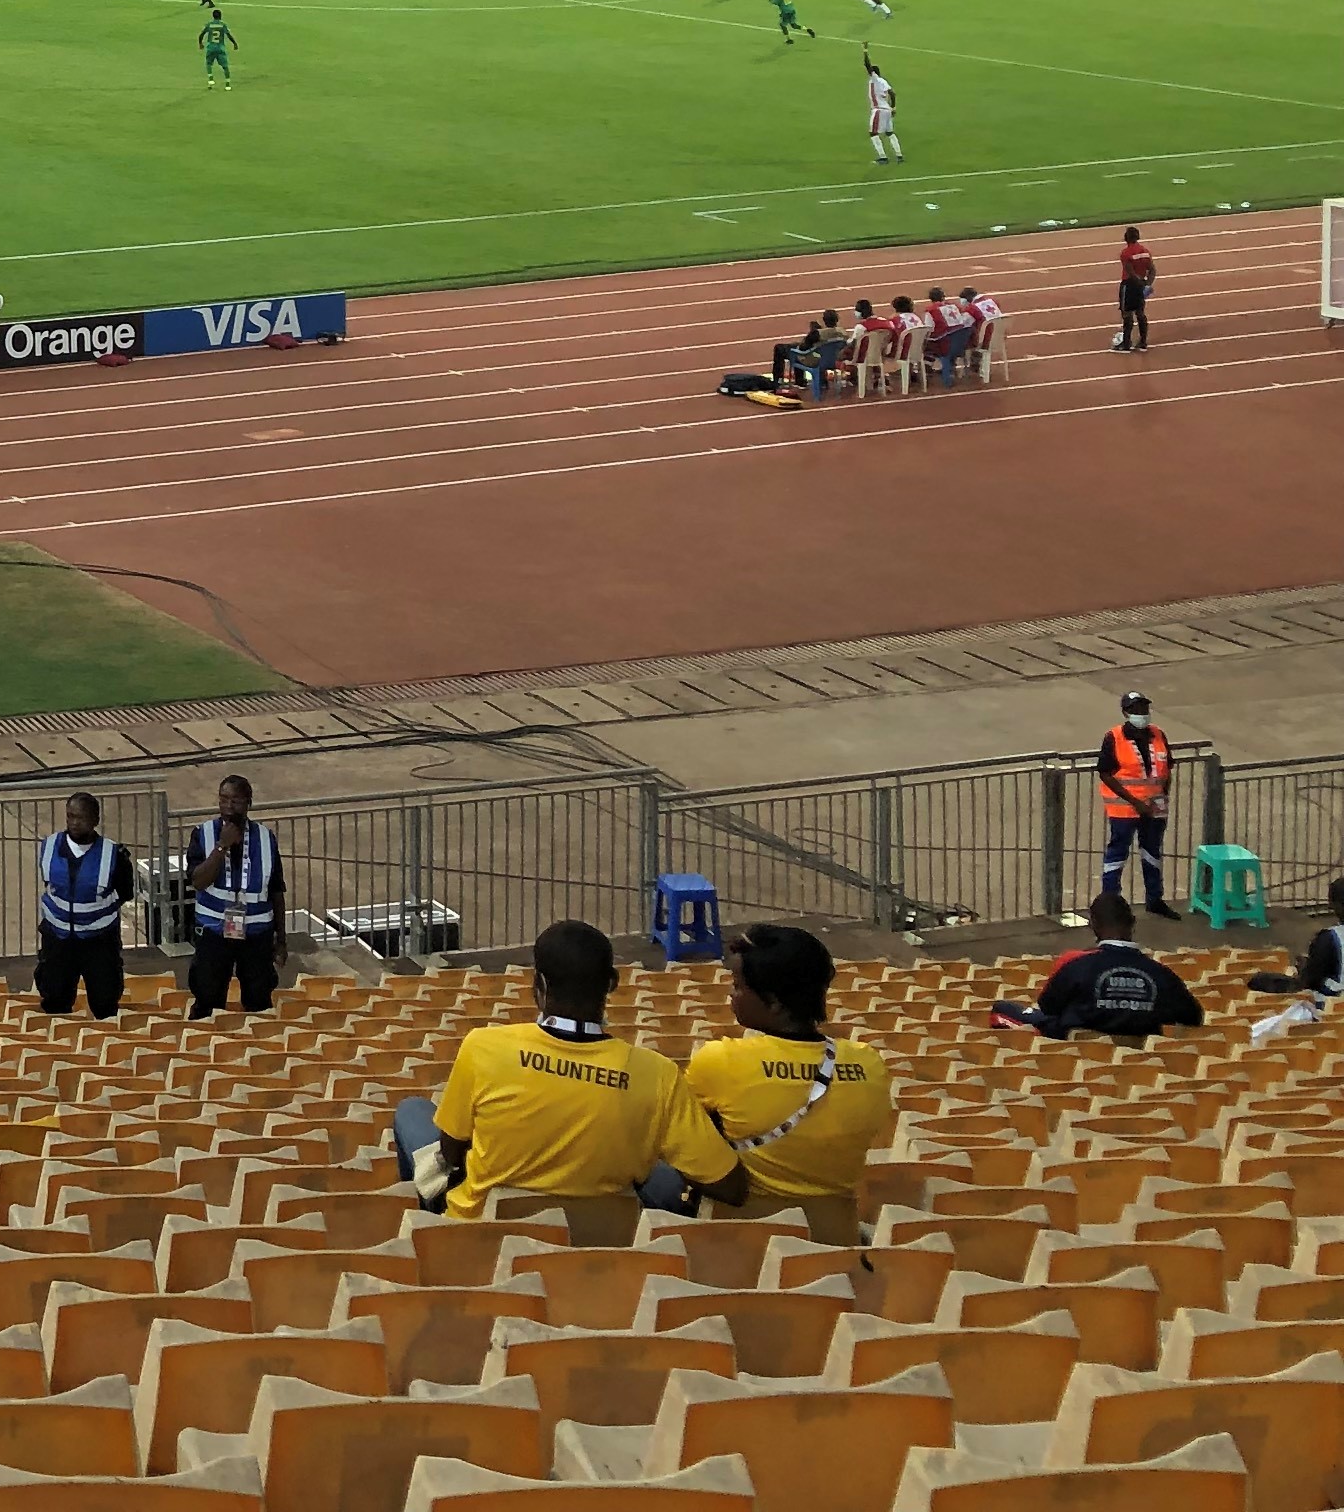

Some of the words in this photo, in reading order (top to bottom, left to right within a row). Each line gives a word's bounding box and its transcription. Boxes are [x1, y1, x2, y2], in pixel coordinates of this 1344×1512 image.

[4, 323, 136, 359] Orange
[192, 299, 302, 346] VISA
[519, 1049, 630, 1090] VOLUNTEER
